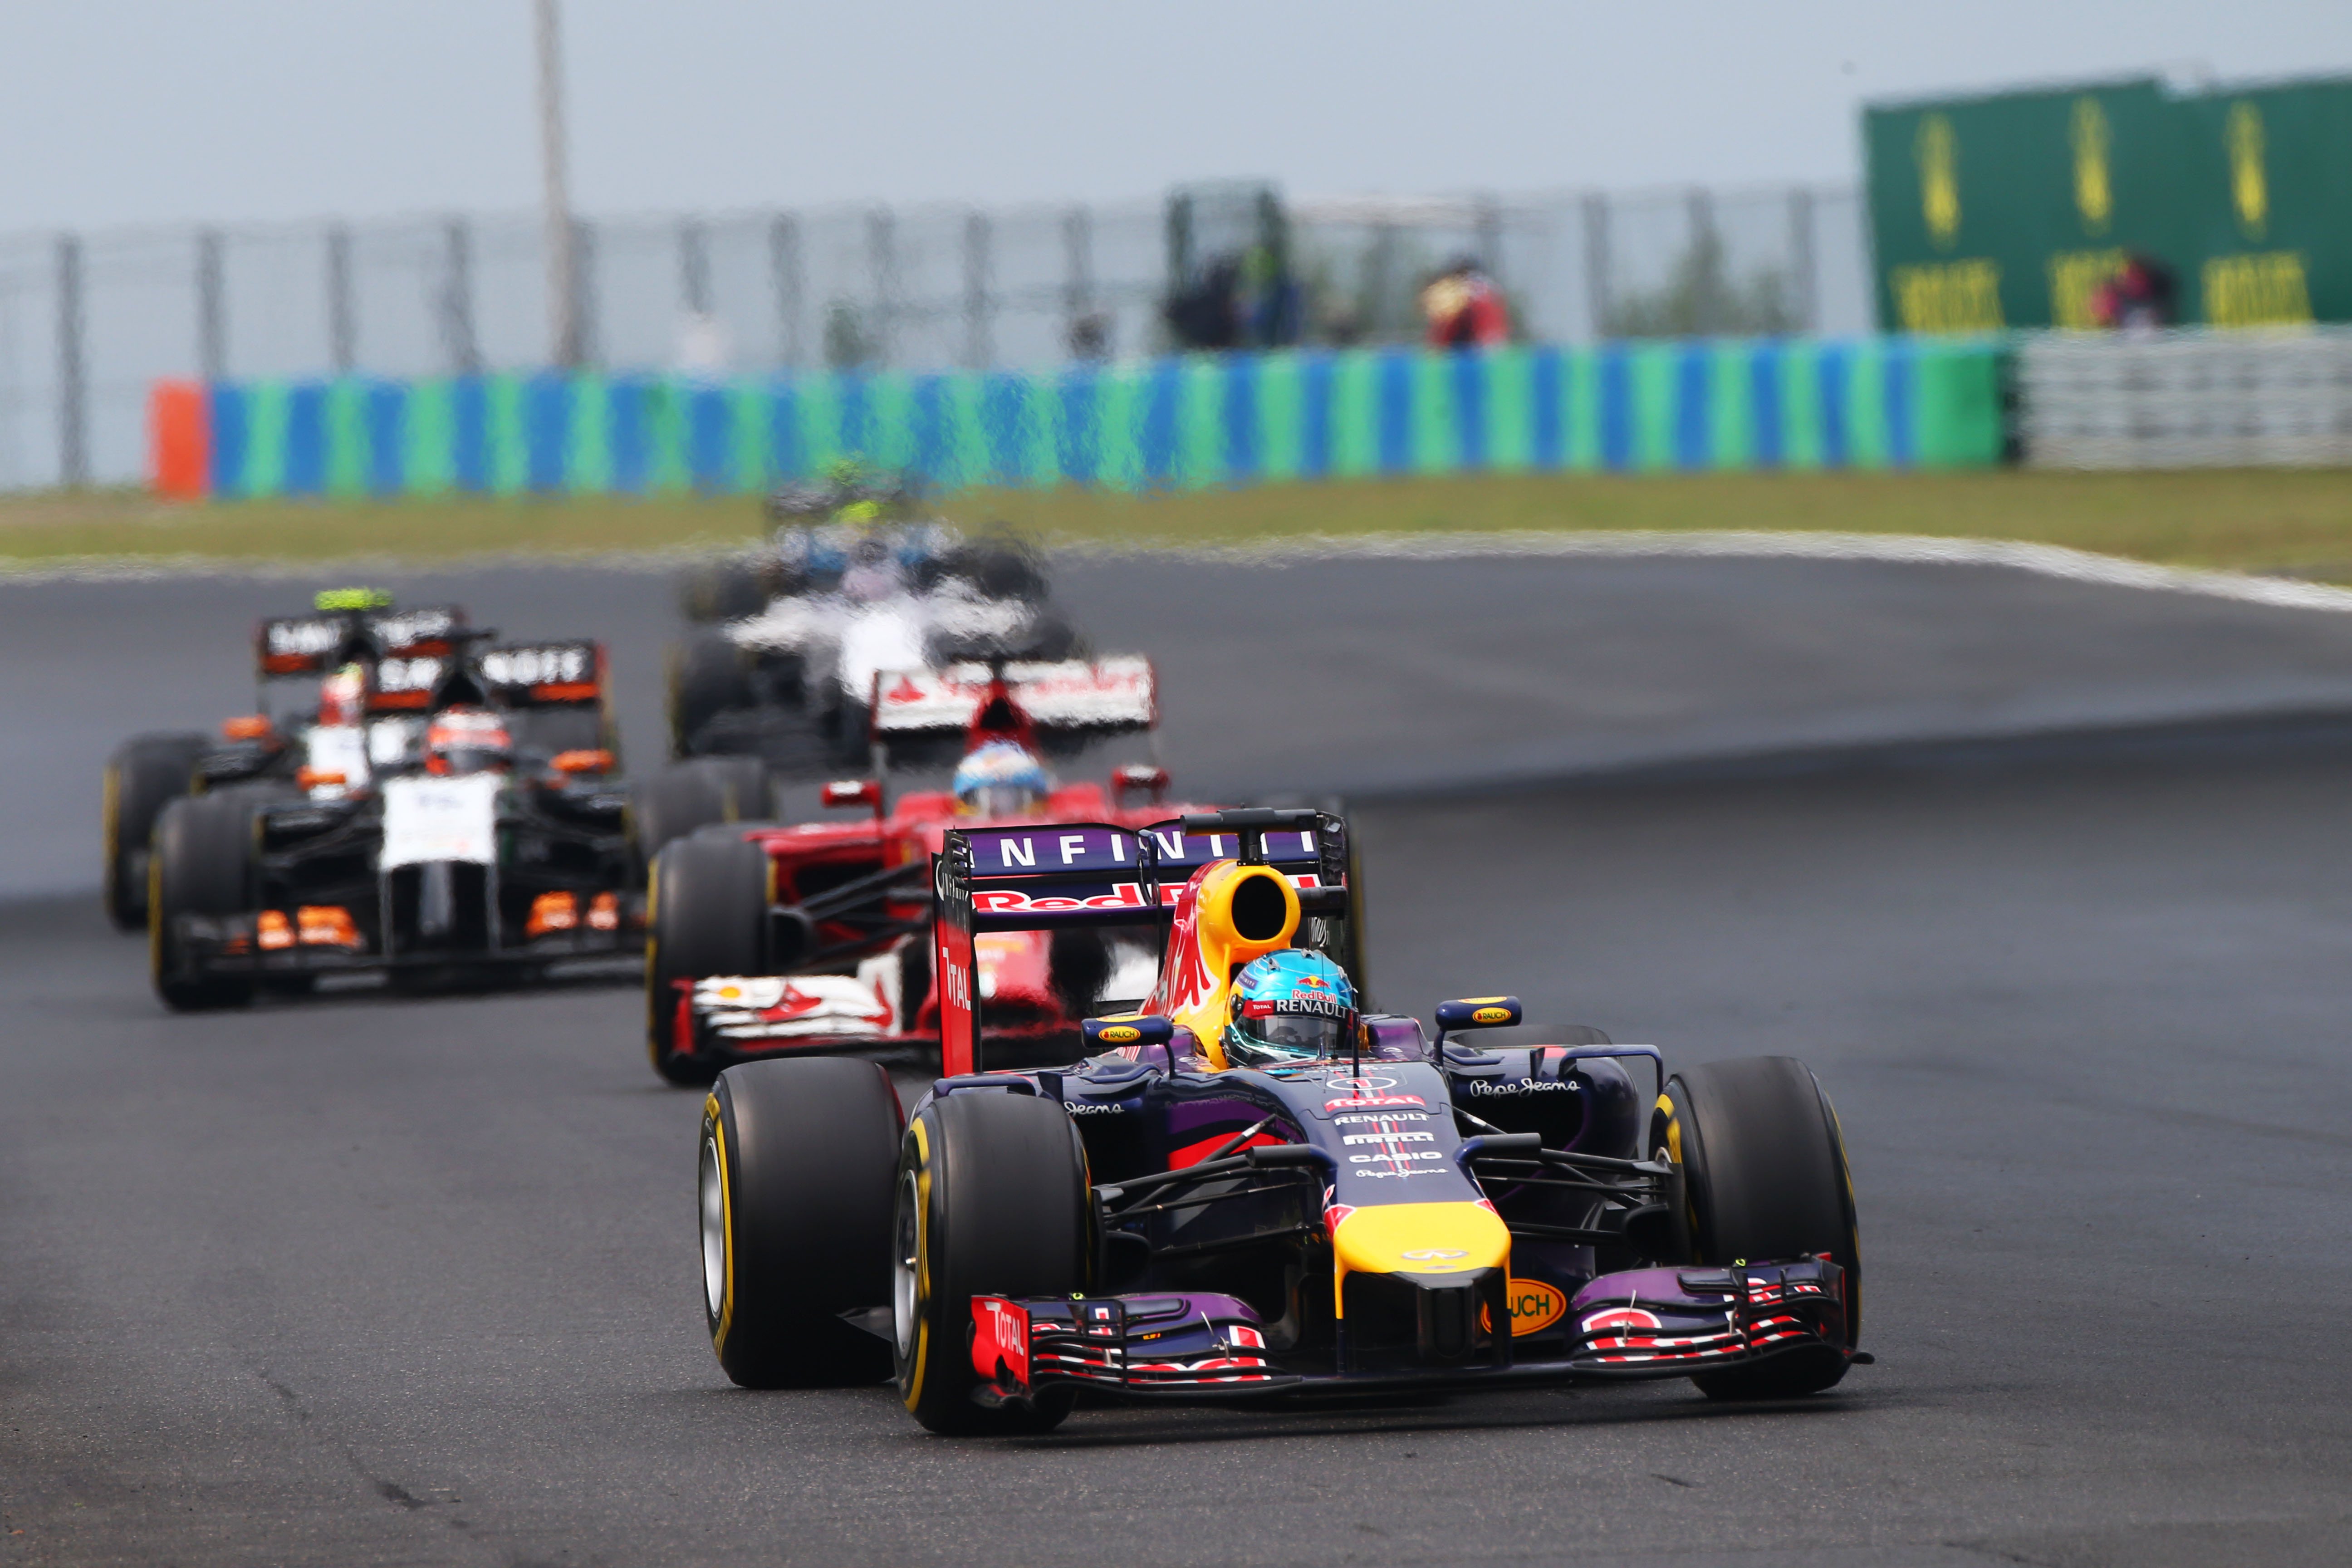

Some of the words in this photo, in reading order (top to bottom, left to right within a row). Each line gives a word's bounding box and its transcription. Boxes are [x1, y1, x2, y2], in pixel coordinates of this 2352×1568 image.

[962, 831, 1314, 868] NFINII
[970, 882, 1147, 912] Red
[942, 946, 971, 1011] TTAL
[1292, 989, 1315, 1000] Red
[1317, 990, 1338, 1004] Bull
[1276, 1000, 1348, 1019] RENAULT
[1110, 1030, 1135, 1039] RAUCH
[1470, 1079, 1519, 1098] Pepe
[1518, 1078, 1582, 1098] Jeans
[1326, 1096, 1425, 1107] TOTAL
[1334, 1113, 1430, 1126] RENAULT
[1348, 1151, 1443, 1163] CASIO
[1511, 1294, 1550, 1318] UCH
[983, 1301, 1024, 1356] TOTAL
